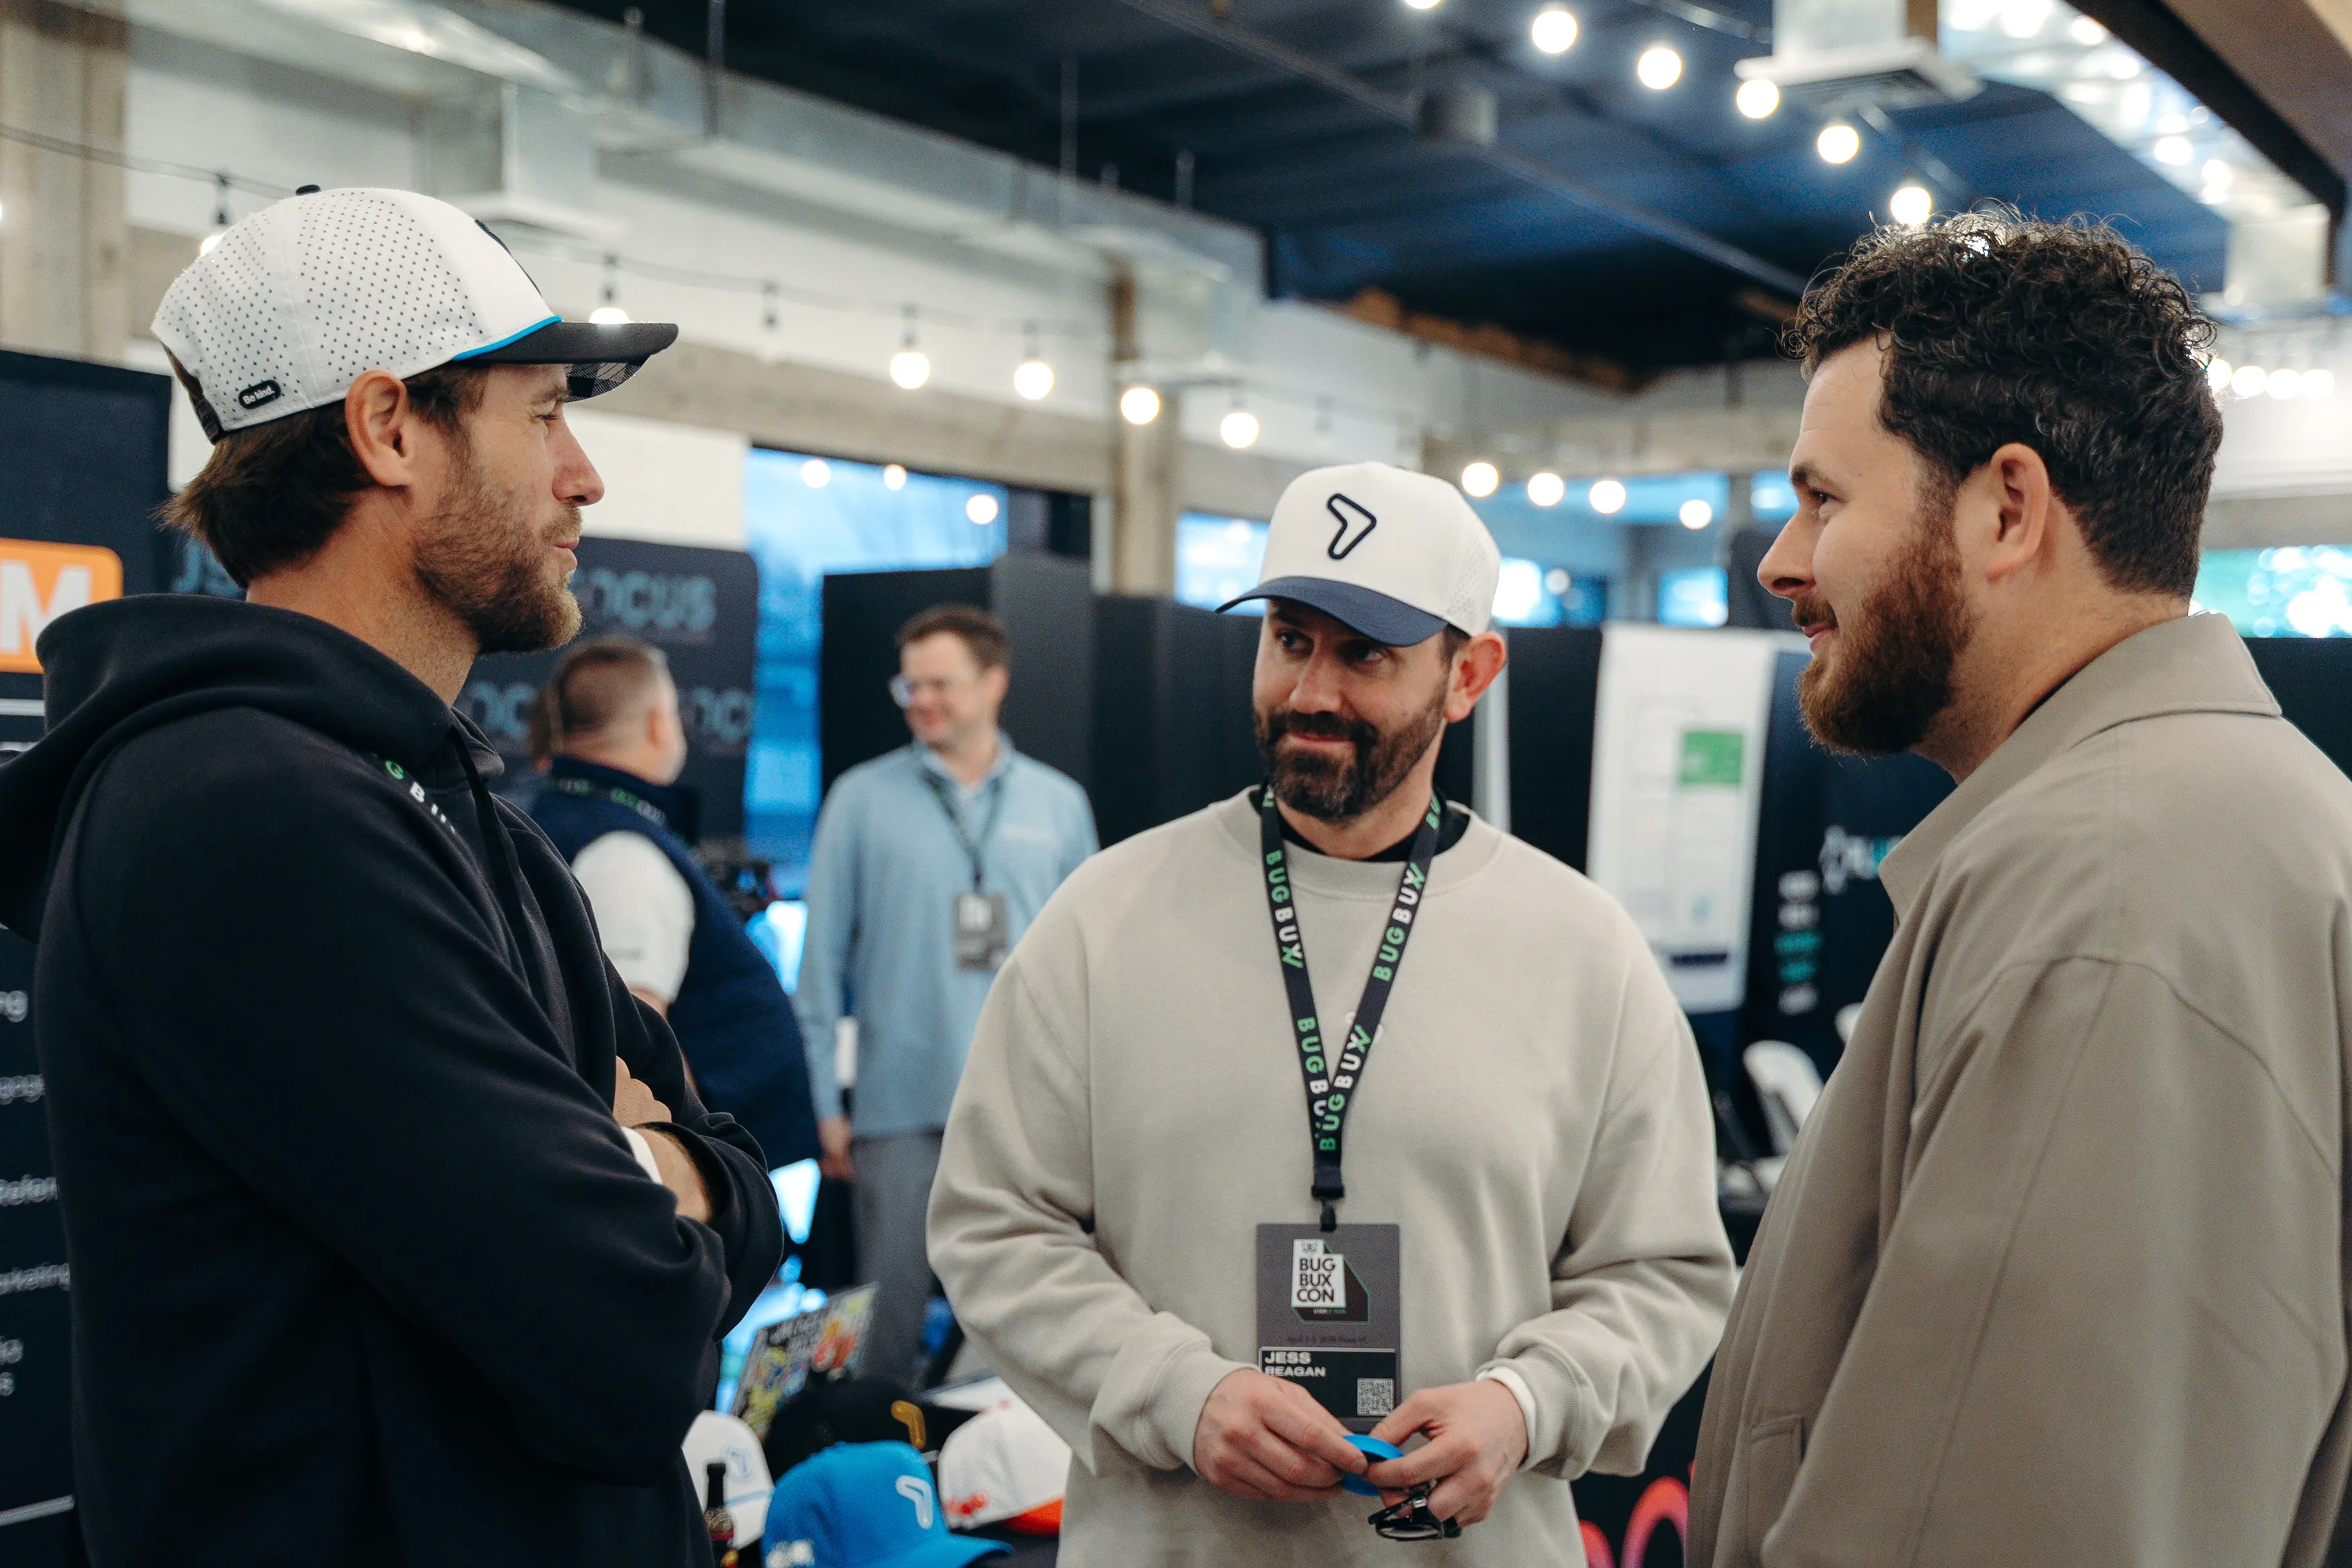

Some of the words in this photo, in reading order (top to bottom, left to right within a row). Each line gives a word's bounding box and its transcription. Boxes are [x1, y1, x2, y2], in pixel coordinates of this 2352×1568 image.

[242, 395, 256, 405] Be
[1300, 1258, 1336, 1272] BUG
[1300, 1273, 1332, 1287] BUX
[1297, 1289, 1335, 1303] CON
[1264, 1351, 1312, 1365] JESS
[1265, 1365, 1326, 1377] REAGAN
